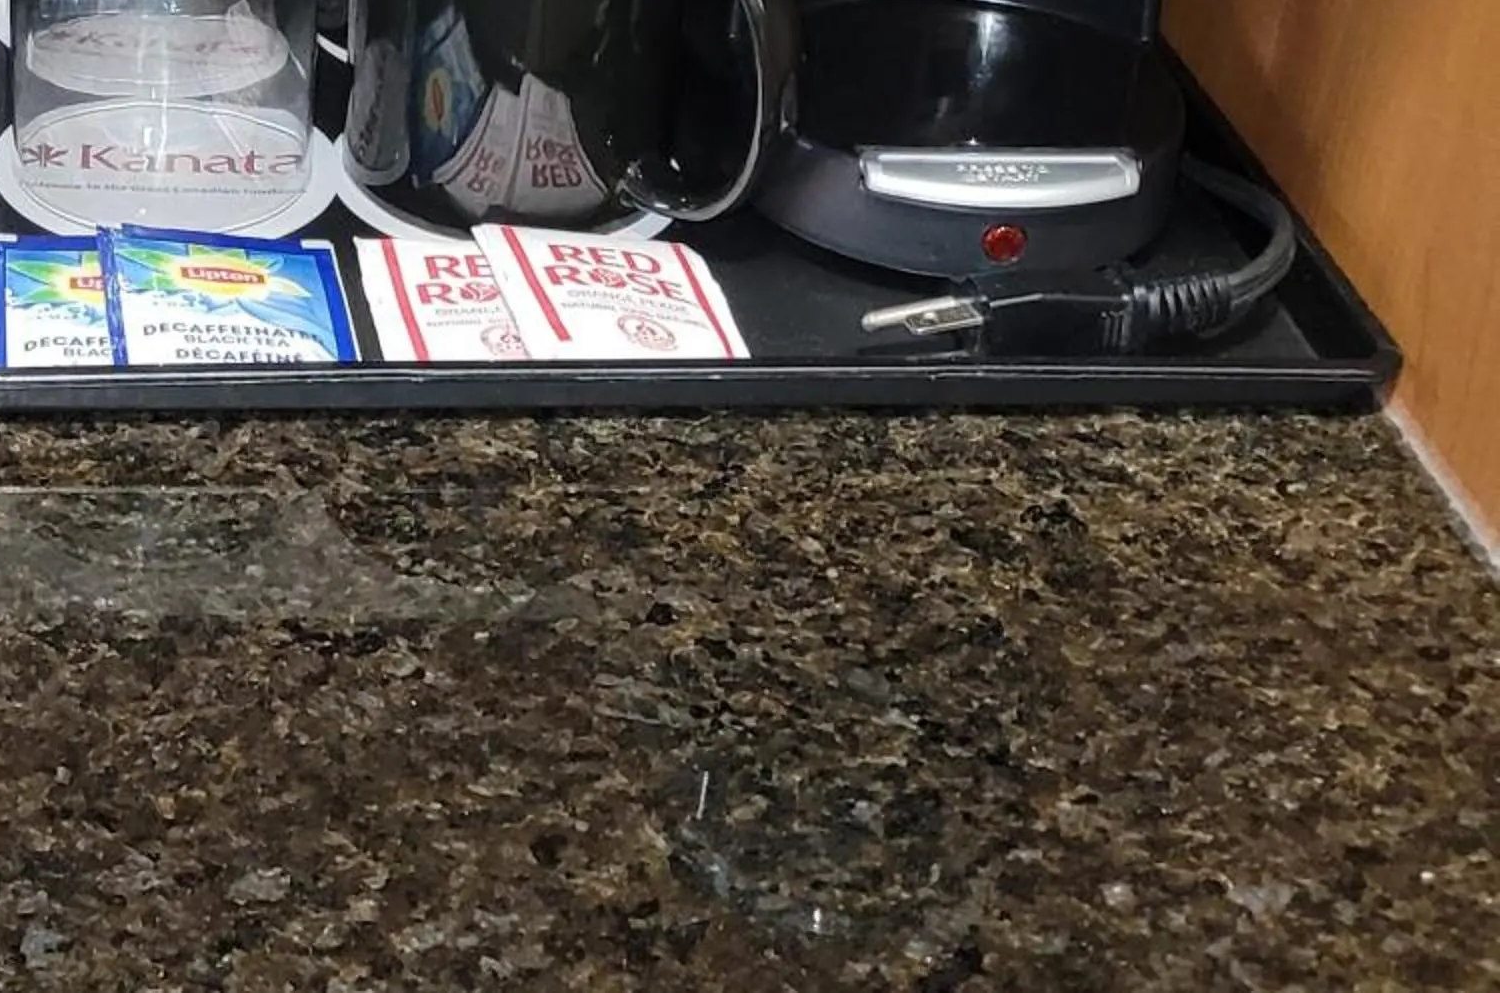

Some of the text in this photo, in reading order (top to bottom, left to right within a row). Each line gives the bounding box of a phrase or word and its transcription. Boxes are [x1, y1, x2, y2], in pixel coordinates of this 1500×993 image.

[80, 144, 304, 176] Kanata
[423, 254, 495, 280] RE
[547, 243, 661, 275] RED
[77, 277, 105, 291] Lip
[186, 267, 260, 284] Lipton
[543, 264, 698, 307] ROSE
[415, 281, 501, 305] RO
[23, 336, 109, 352] DECAFF
[183, 334, 291, 348] BLACK TEA
[63, 346, 113, 358] BLAC
